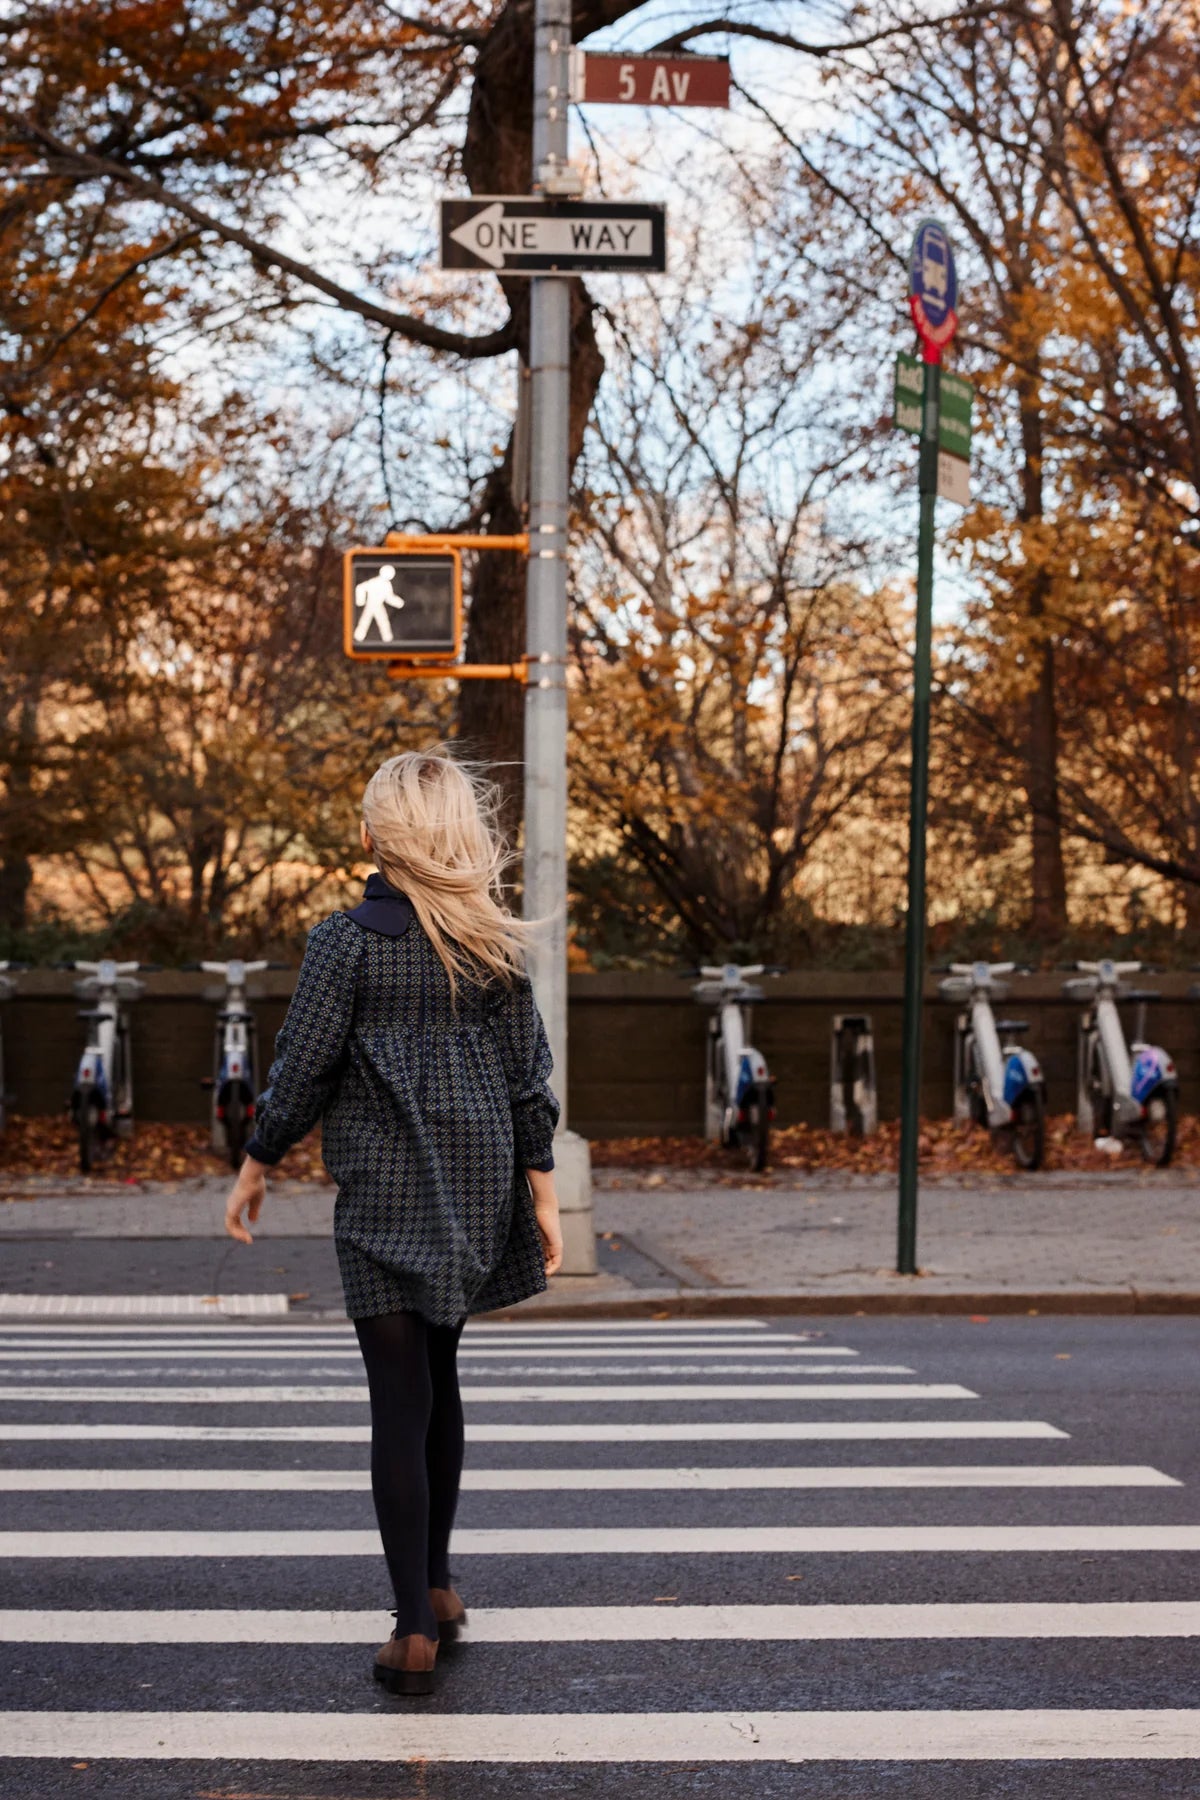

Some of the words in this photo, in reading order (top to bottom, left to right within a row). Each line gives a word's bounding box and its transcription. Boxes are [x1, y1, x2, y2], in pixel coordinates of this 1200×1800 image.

[619, 63, 636, 101] 5
[475, 222, 538, 249] ONE
[570, 224, 636, 251] WAY
